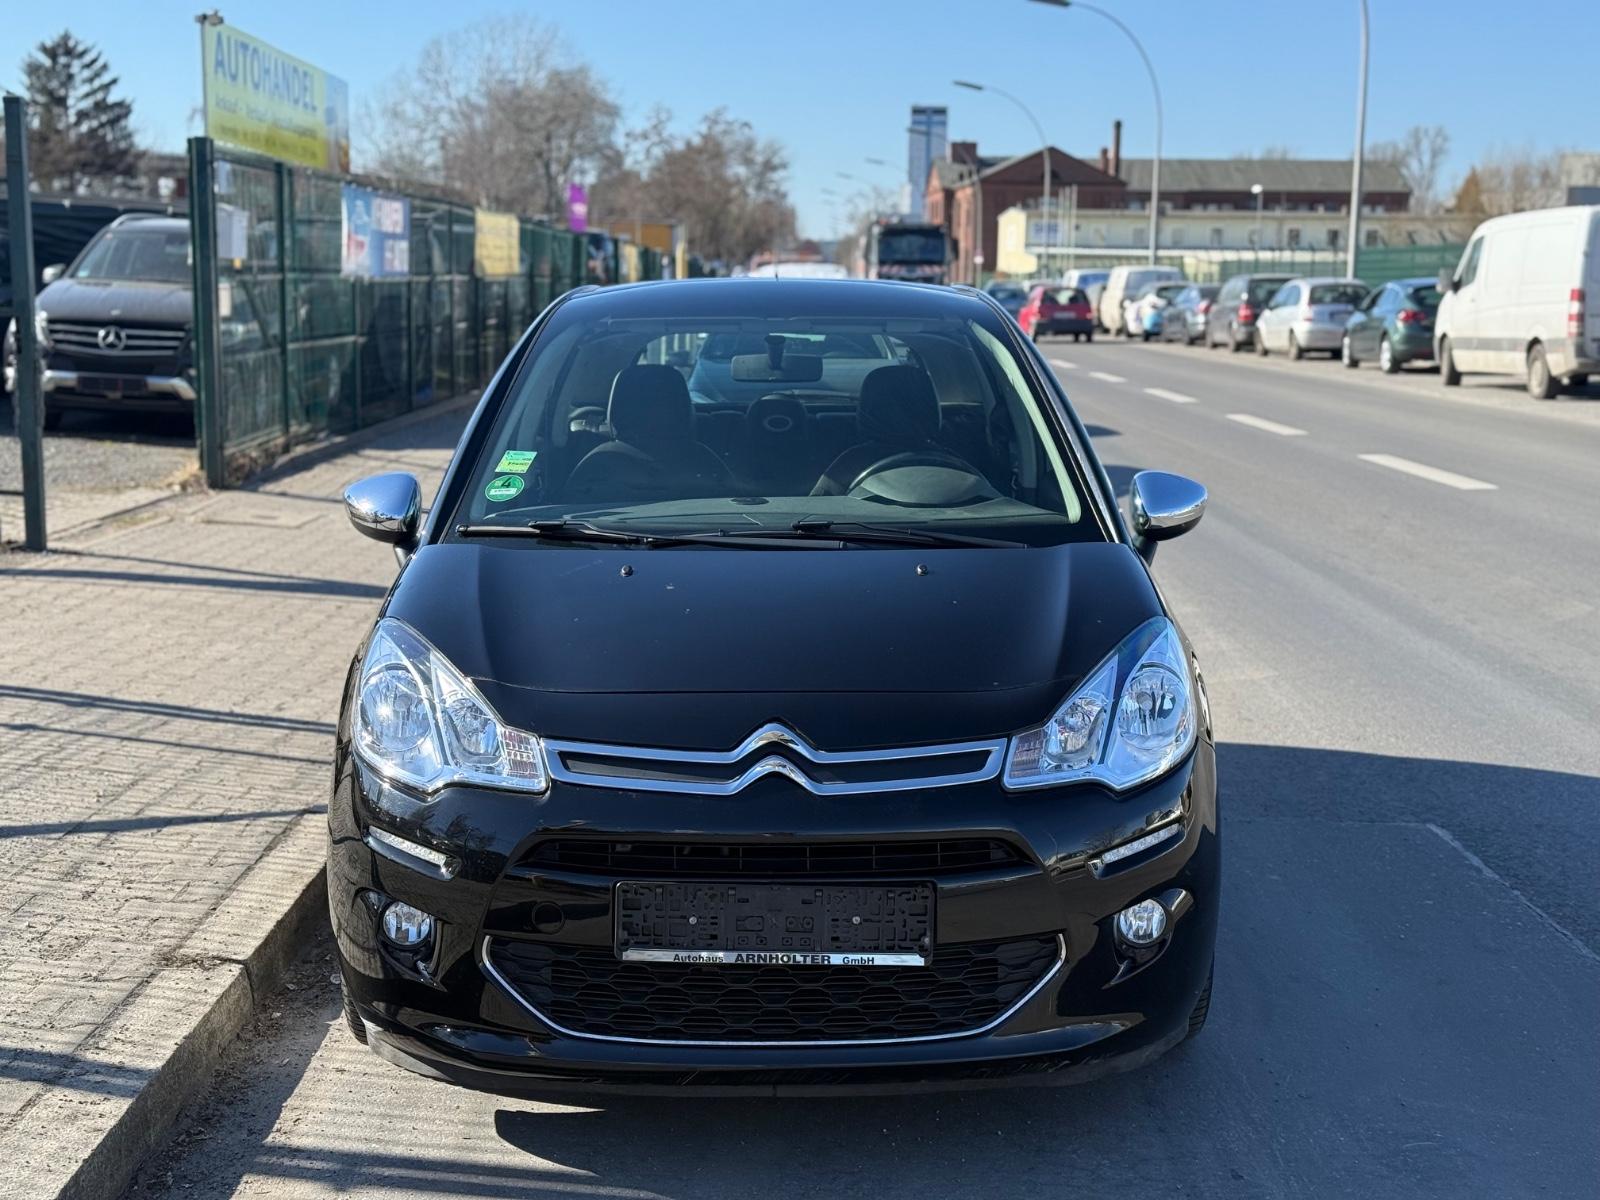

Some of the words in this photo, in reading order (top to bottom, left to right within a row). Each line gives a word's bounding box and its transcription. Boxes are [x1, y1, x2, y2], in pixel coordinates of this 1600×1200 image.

[213, 31, 318, 112] AUTOHANDEL
[501, 477, 512, 488] 4
[673, 953, 724, 963] Autohaus
[842, 956, 875, 965] GmbH
